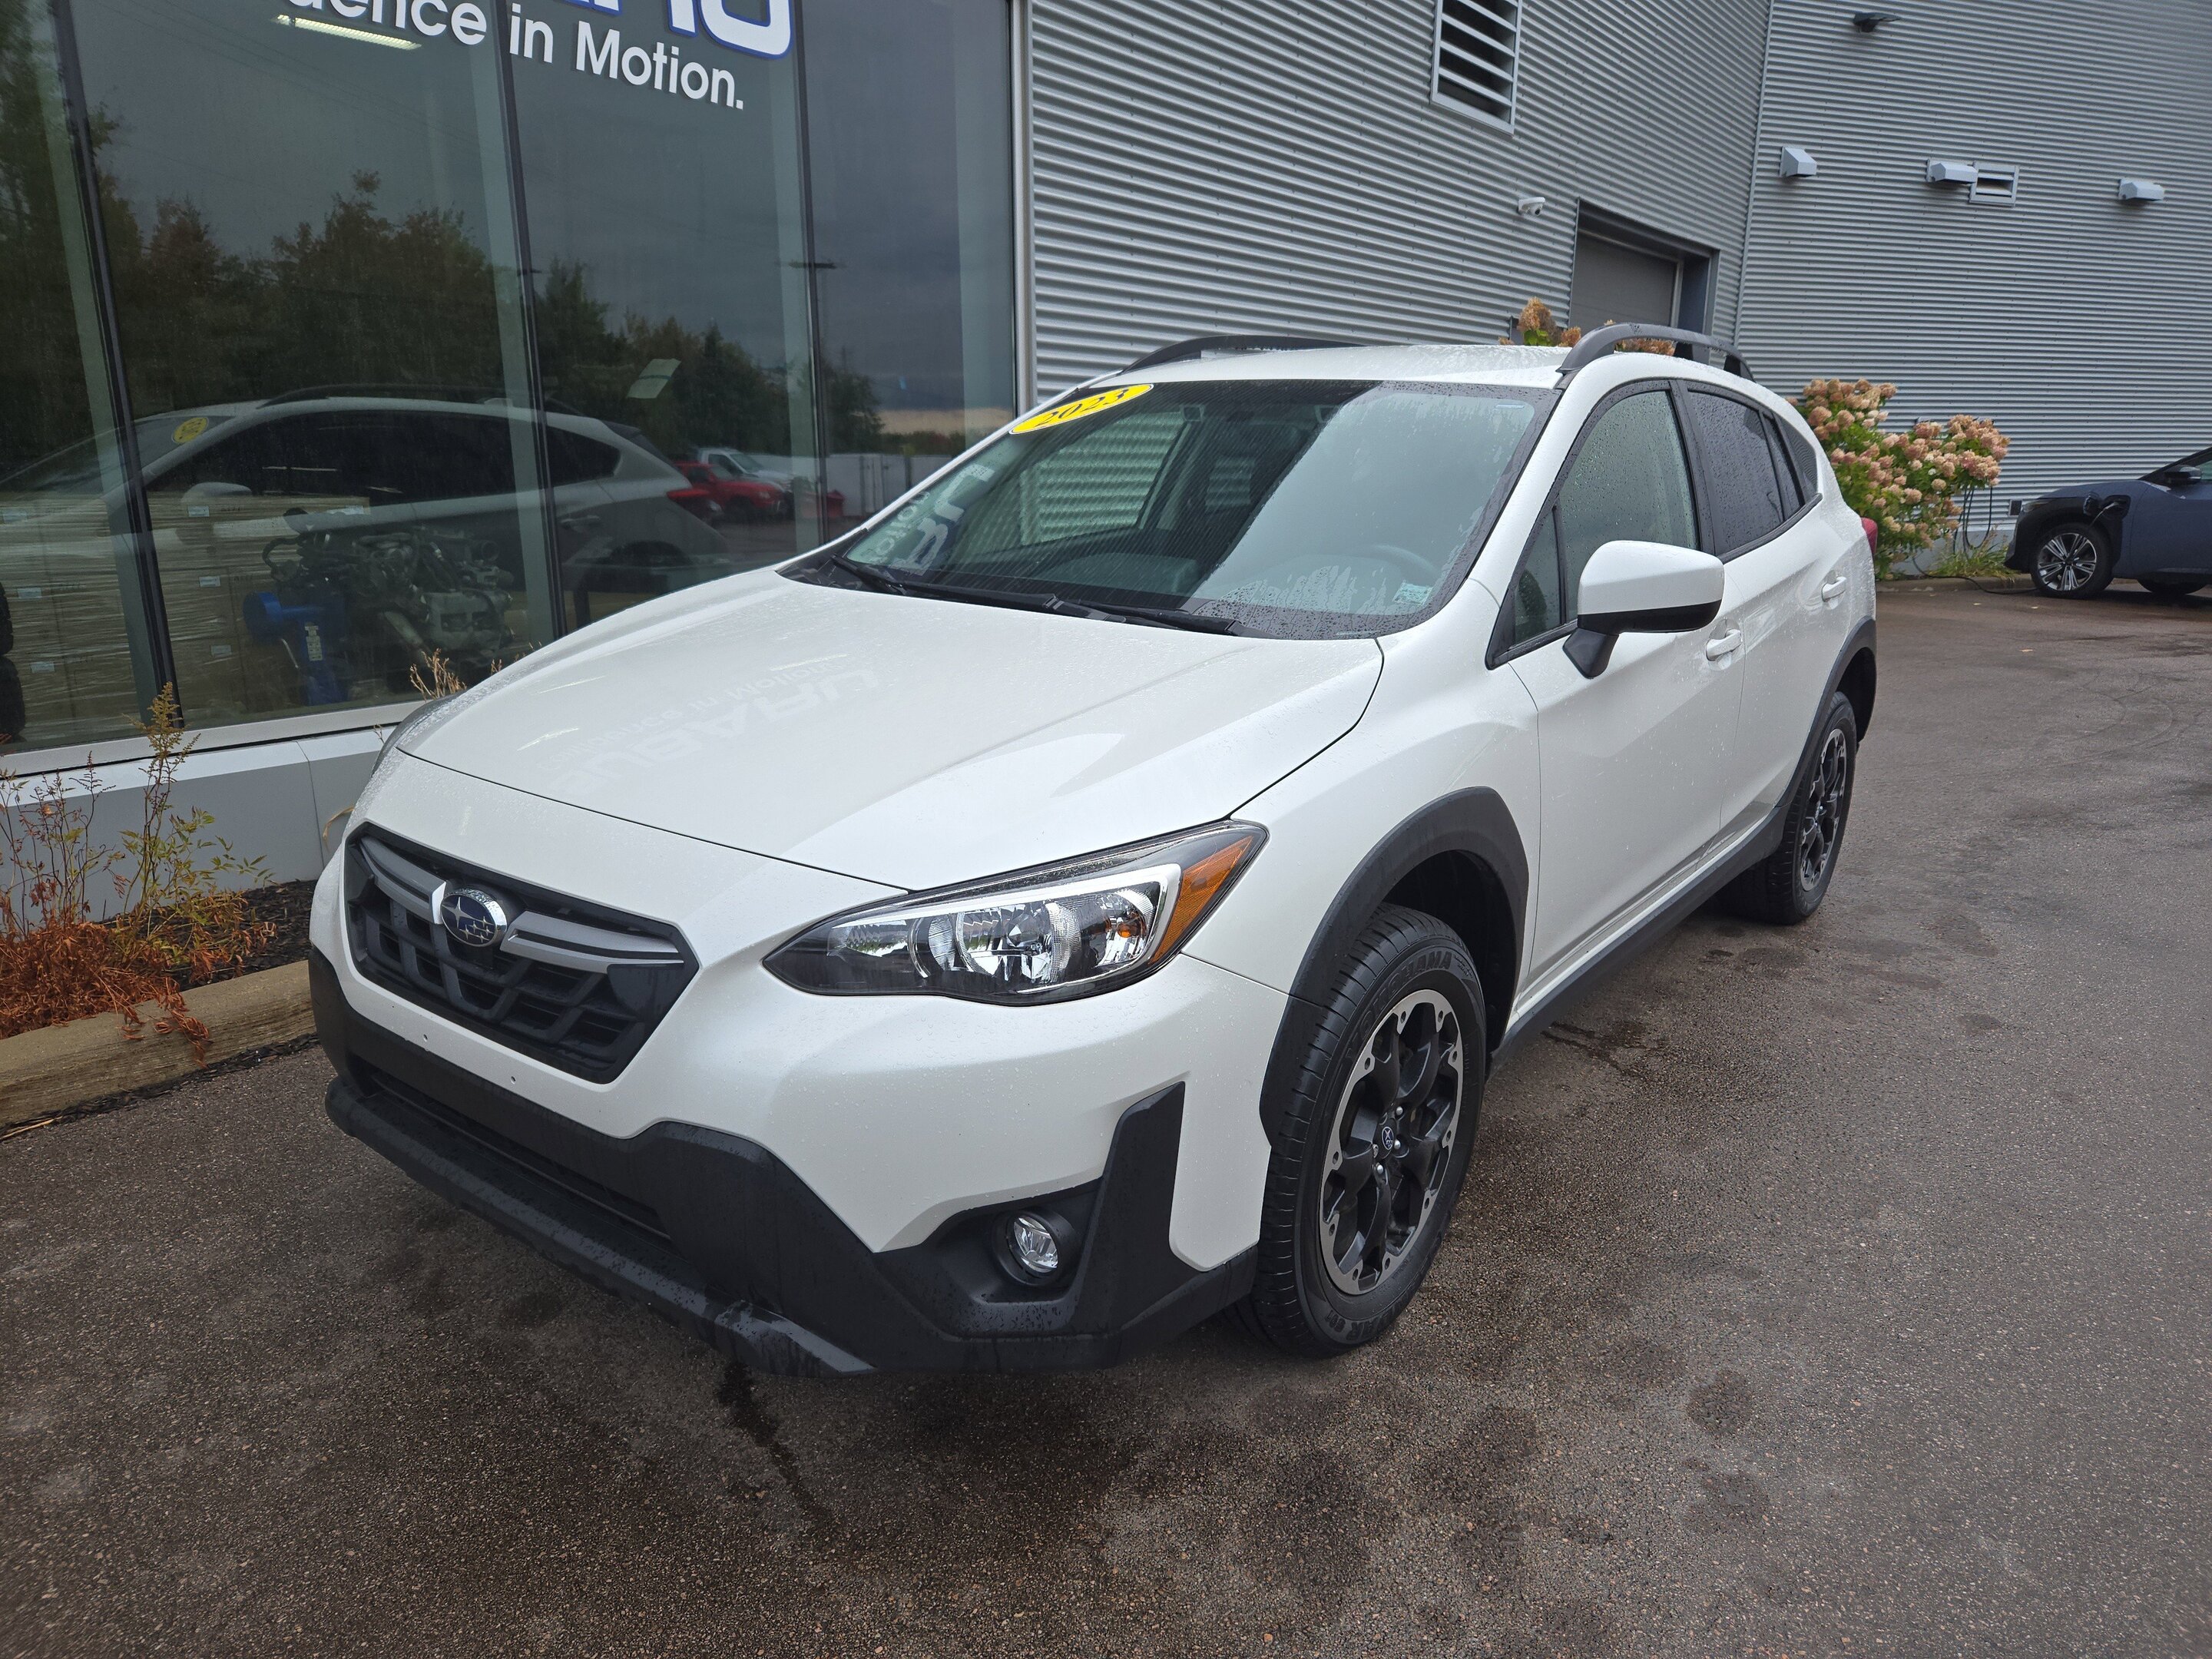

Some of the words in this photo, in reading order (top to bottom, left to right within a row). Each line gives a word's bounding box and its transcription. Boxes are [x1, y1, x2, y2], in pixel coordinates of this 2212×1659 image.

[286, 0, 487, 45] nce
[509, 3, 554, 63] in
[576, 21, 743, 110] Motion.
[1035, 389, 1129, 427] 2023
